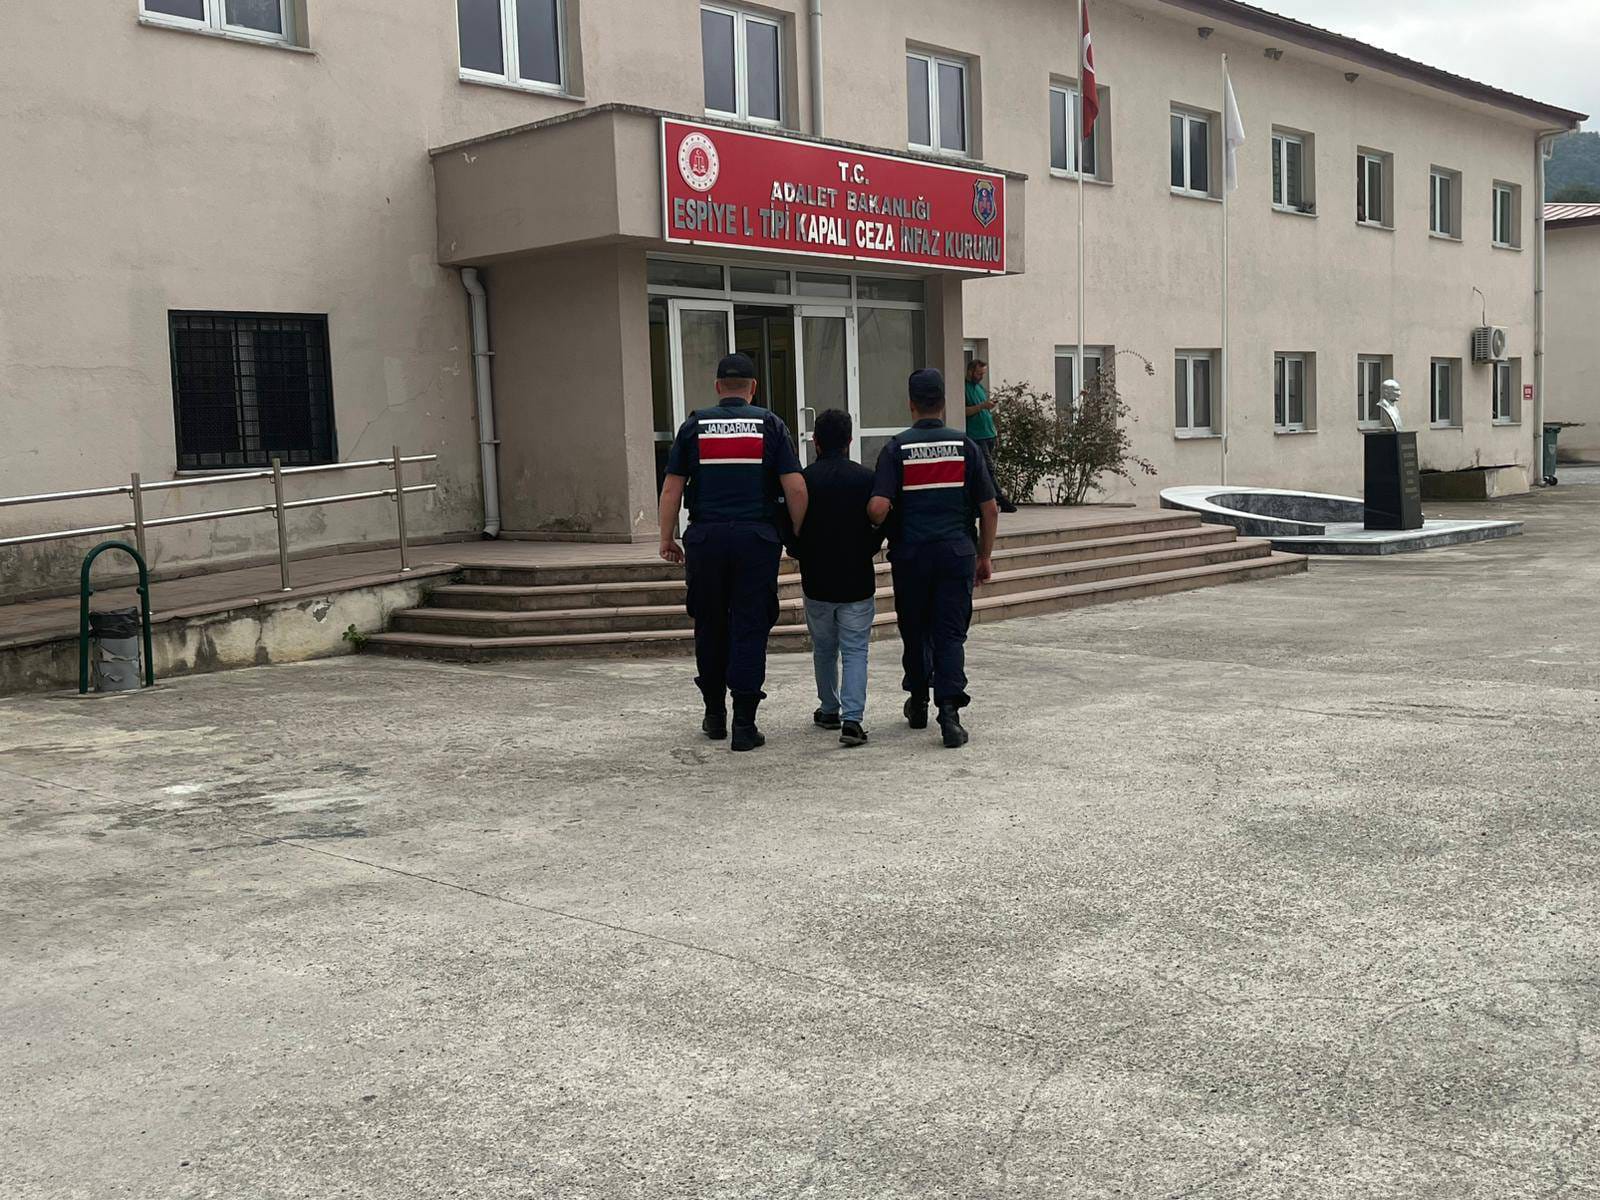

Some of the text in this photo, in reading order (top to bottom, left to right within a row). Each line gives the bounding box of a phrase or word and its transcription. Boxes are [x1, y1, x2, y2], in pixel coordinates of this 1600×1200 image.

[838, 161, 870, 185] T.C.
[771, 180, 931, 221] ADALET BAKANLIĞI
[674, 194, 737, 235] ESPİYE
[759, 201, 790, 240] TİPİ
[796, 212, 850, 247] KAPALI
[855, 219, 896, 251] CEZA
[900, 218, 940, 256] İNFAZ
[945, 231, 1001, 262] KURUMU
[705, 422, 758, 434] JANDARMA
[908, 445, 959, 459] JANDARMA
